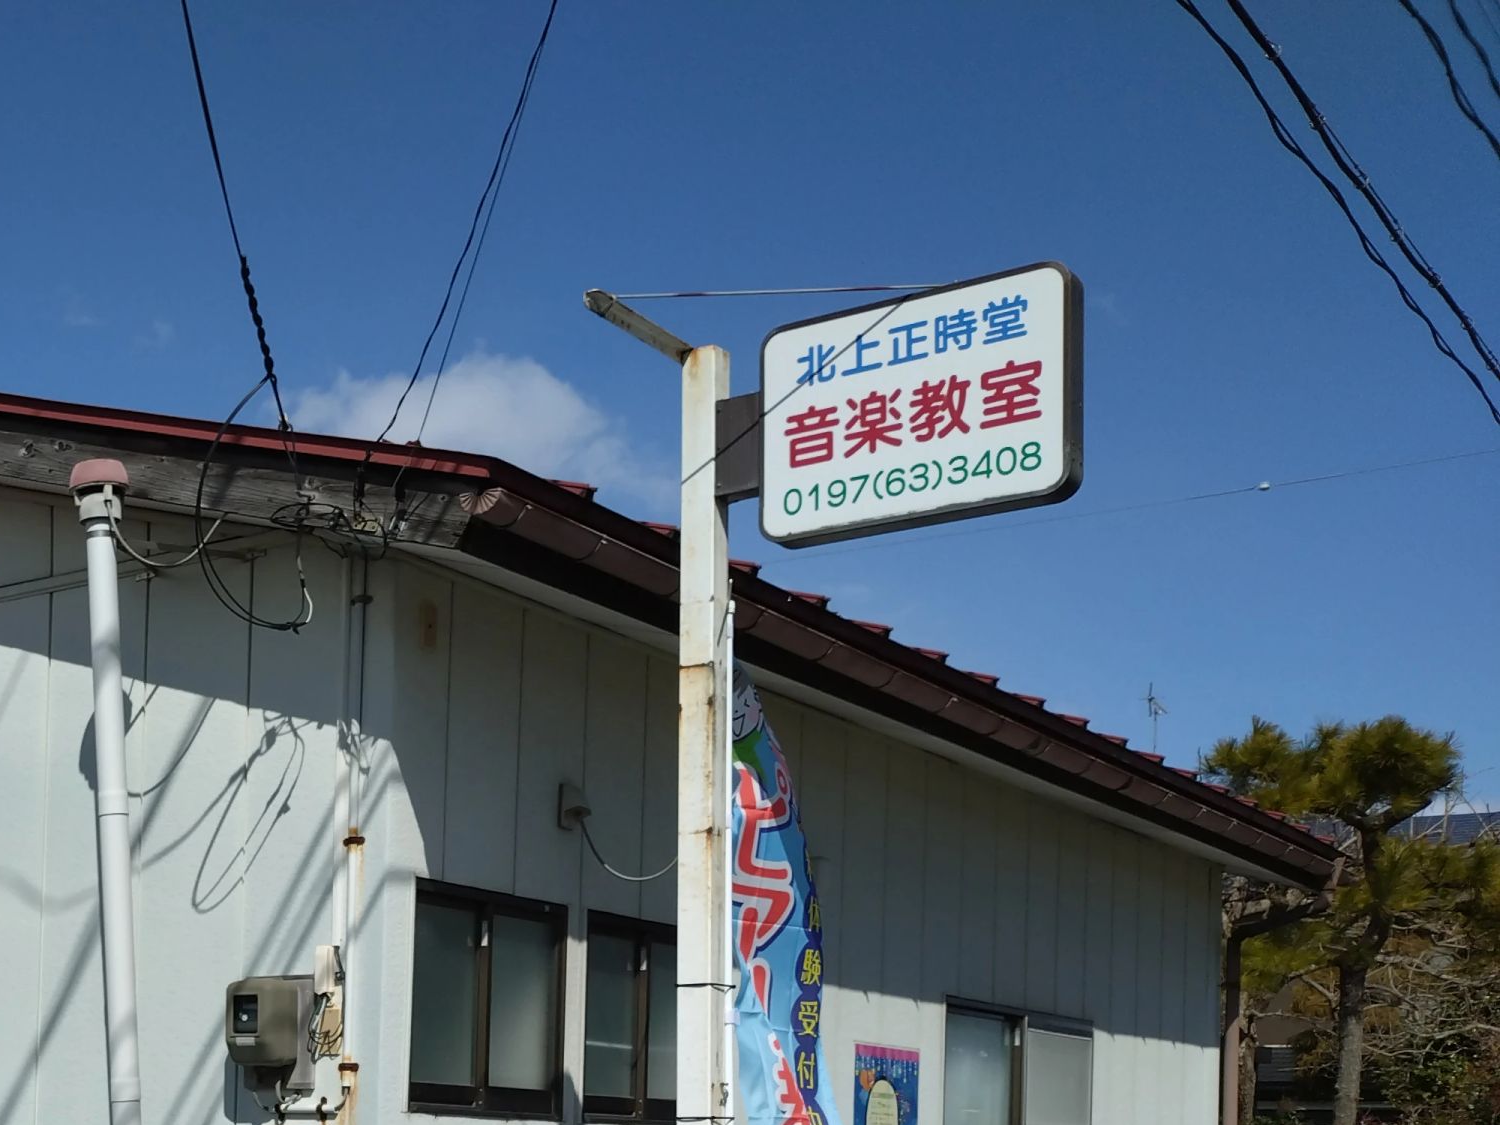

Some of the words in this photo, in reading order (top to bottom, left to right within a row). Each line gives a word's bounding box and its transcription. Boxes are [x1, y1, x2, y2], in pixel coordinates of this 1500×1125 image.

[796, 294, 1028, 386] 北上正時堂
[784, 360, 1043, 468] 音楽教室
[784, 441, 1042, 515] 0197(63)3408
